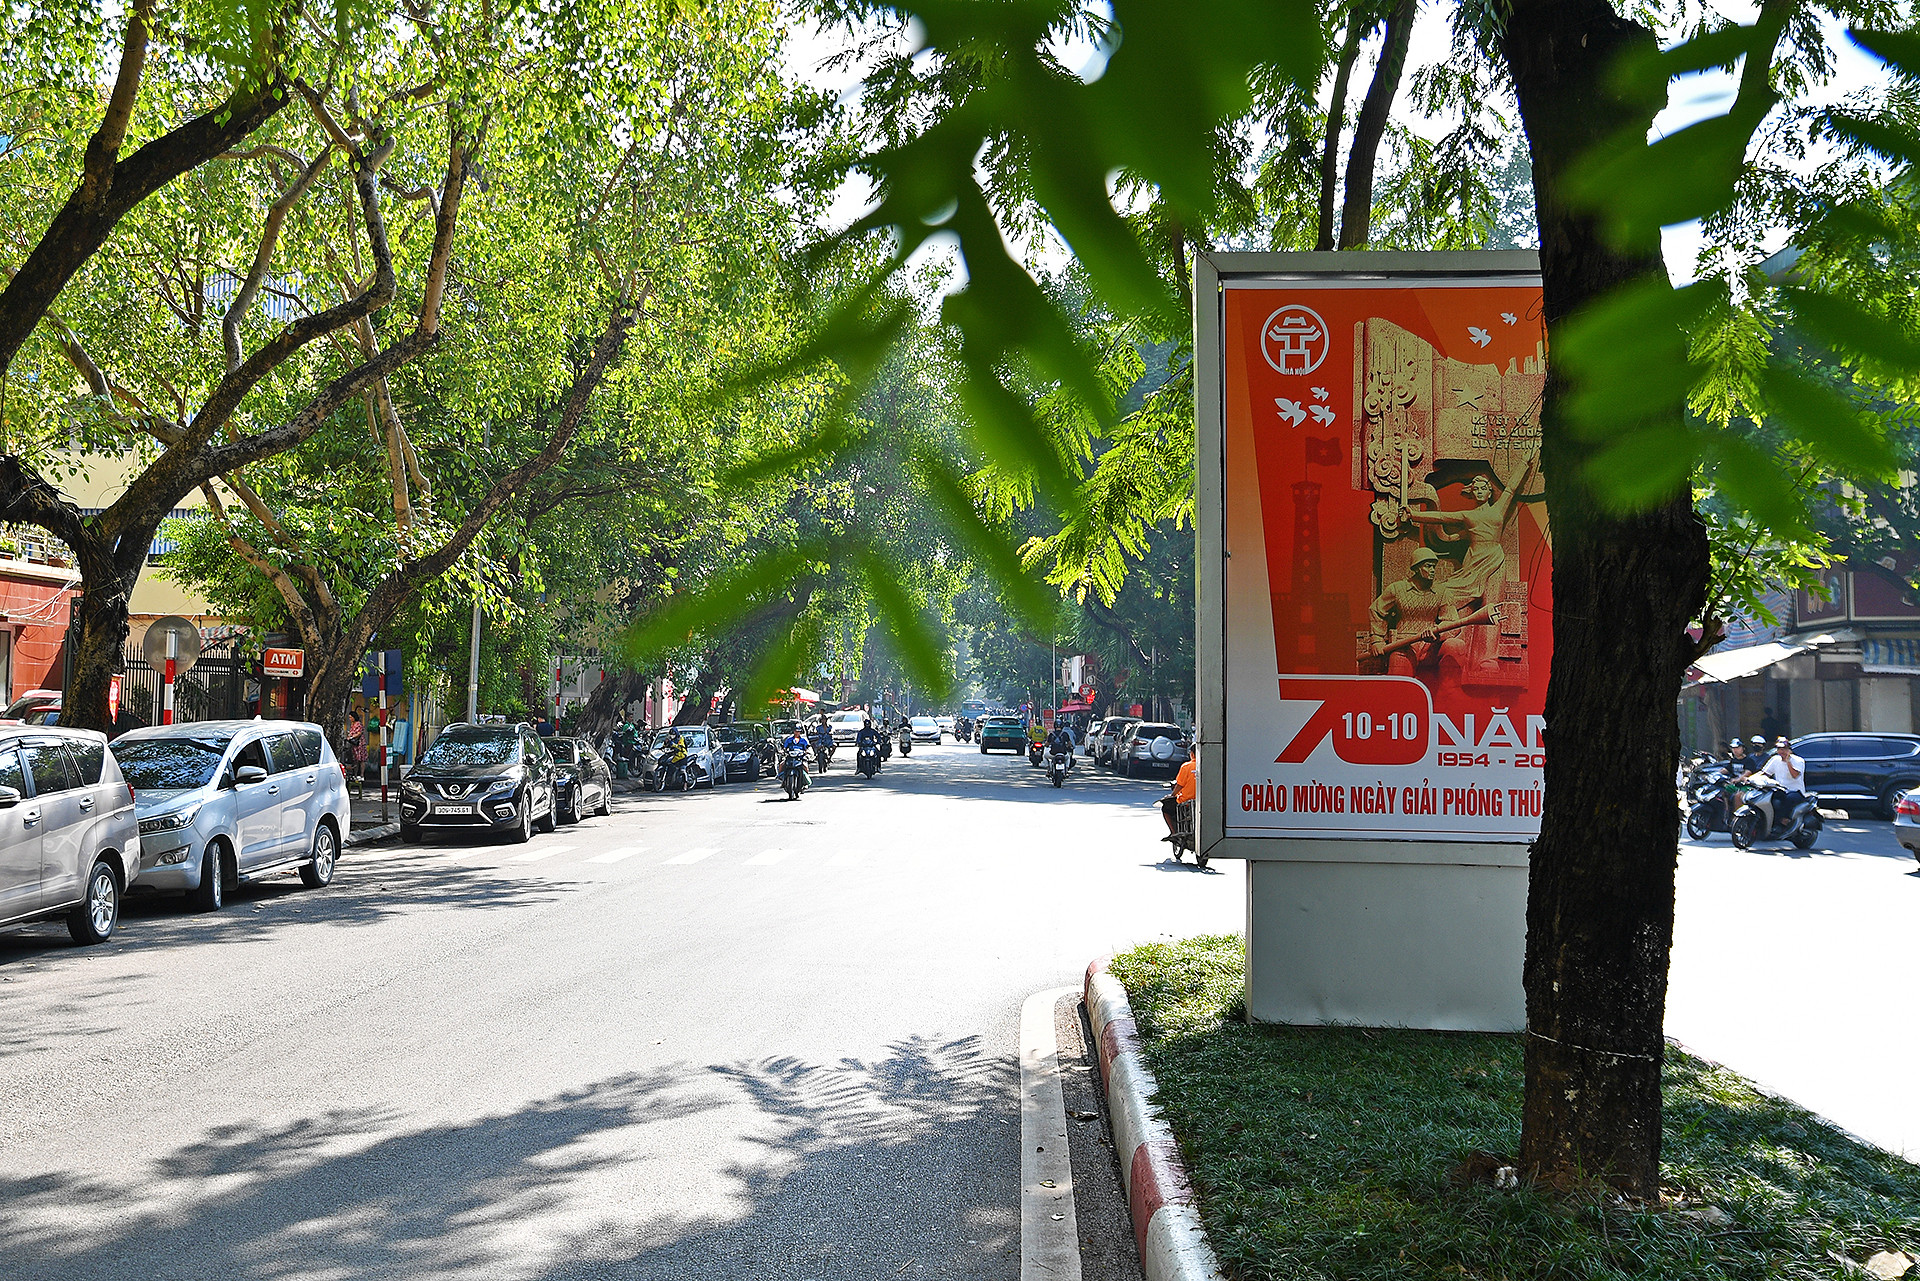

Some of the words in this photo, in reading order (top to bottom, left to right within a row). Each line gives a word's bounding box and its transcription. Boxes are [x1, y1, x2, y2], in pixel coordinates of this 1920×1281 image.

[270, 653, 297, 666] ATM
[1274, 679, 1430, 765] 70
[1341, 712, 1418, 740] 10-10
[1437, 752, 1490, 767] 1954
[1514, 753, 1546, 768] 20
[1241, 778, 1288, 812] CHÀO
[1292, 779, 1345, 814] MỪNG
[1350, 780, 1398, 815] NGÀY
[1402, 777, 1437, 815] GIẢI
[1442, 782, 1503, 817] PHÓNG
[1507, 780, 1541, 817] THỦ
